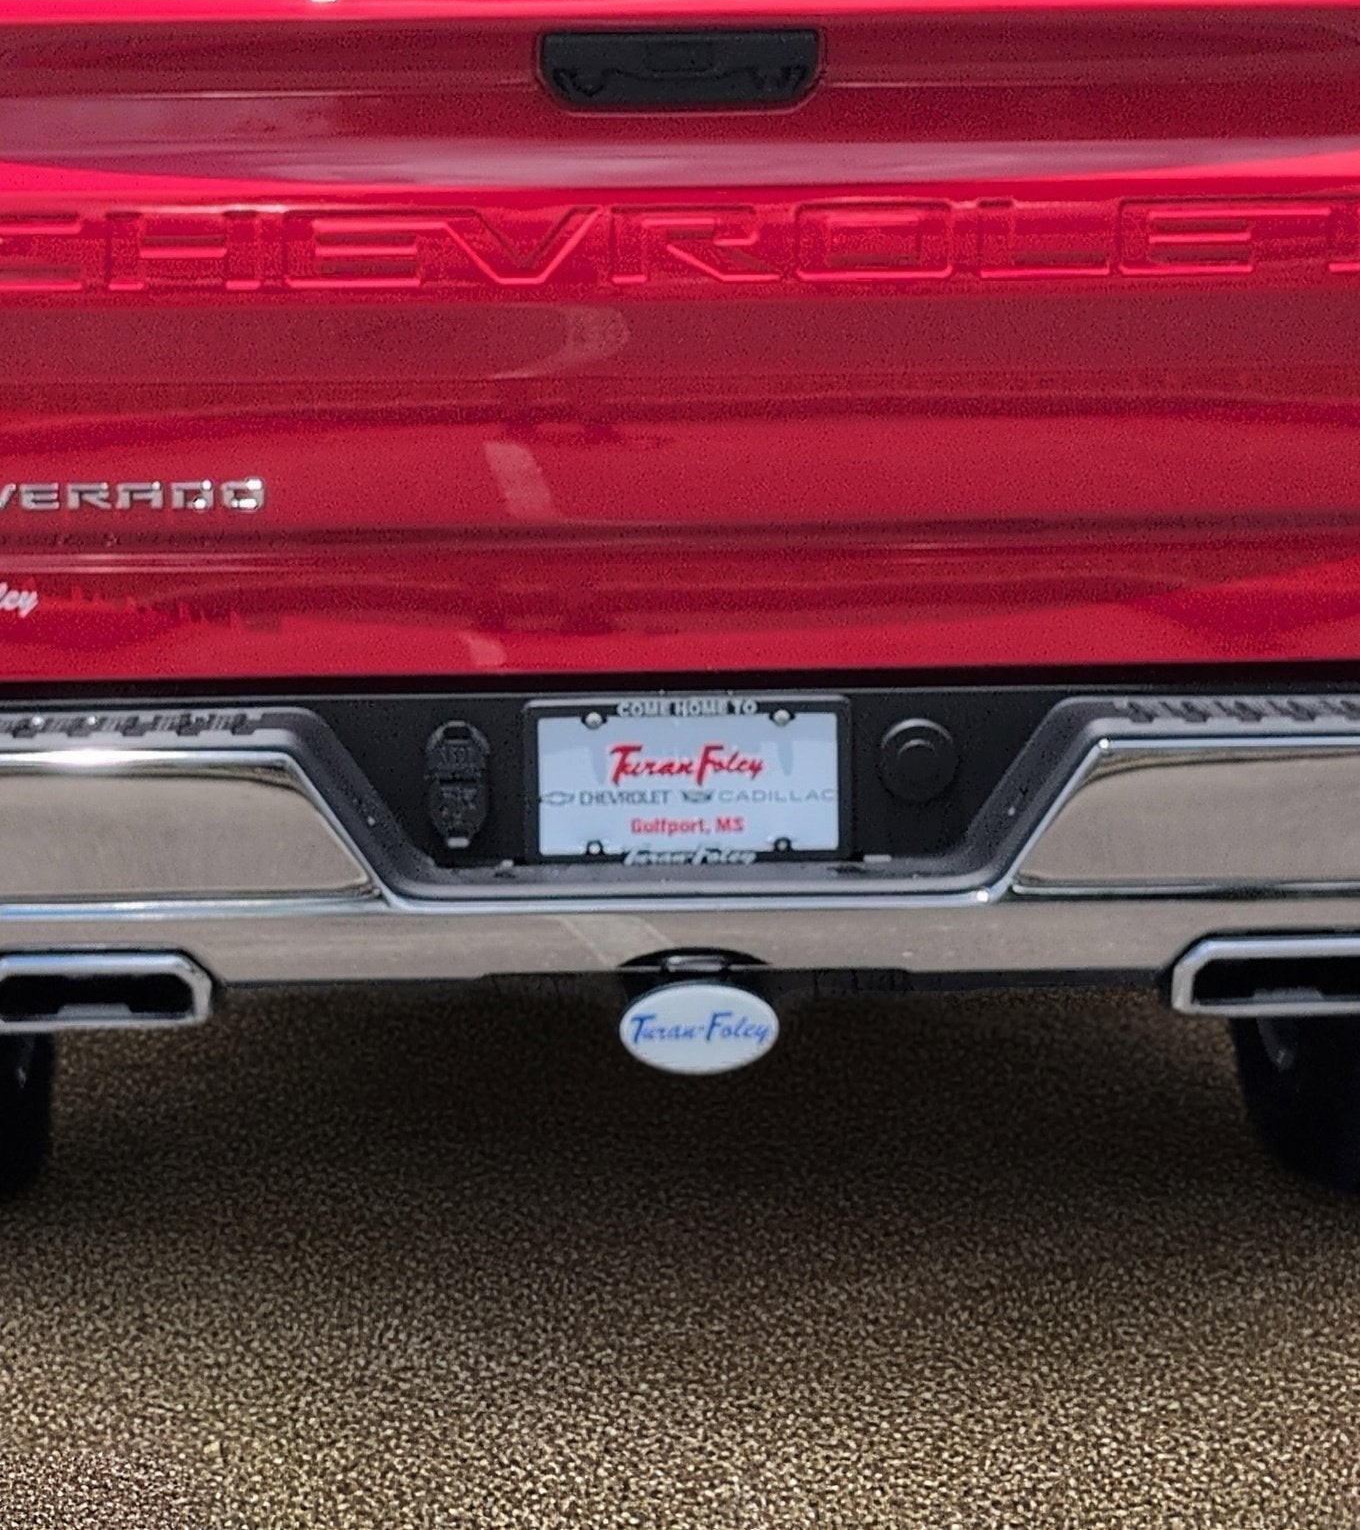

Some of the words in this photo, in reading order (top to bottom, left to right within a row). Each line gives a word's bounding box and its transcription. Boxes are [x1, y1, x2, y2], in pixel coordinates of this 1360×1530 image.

[617, 700, 668, 717] COME
[674, 699, 726, 716] HOME
[727, 698, 758, 715] TO
[580, 790, 669, 805] CHEVROLET
[718, 789, 836, 803] CADILLAC
[630, 819, 711, 835] Gulfport,
[715, 816, 745, 832] MS
